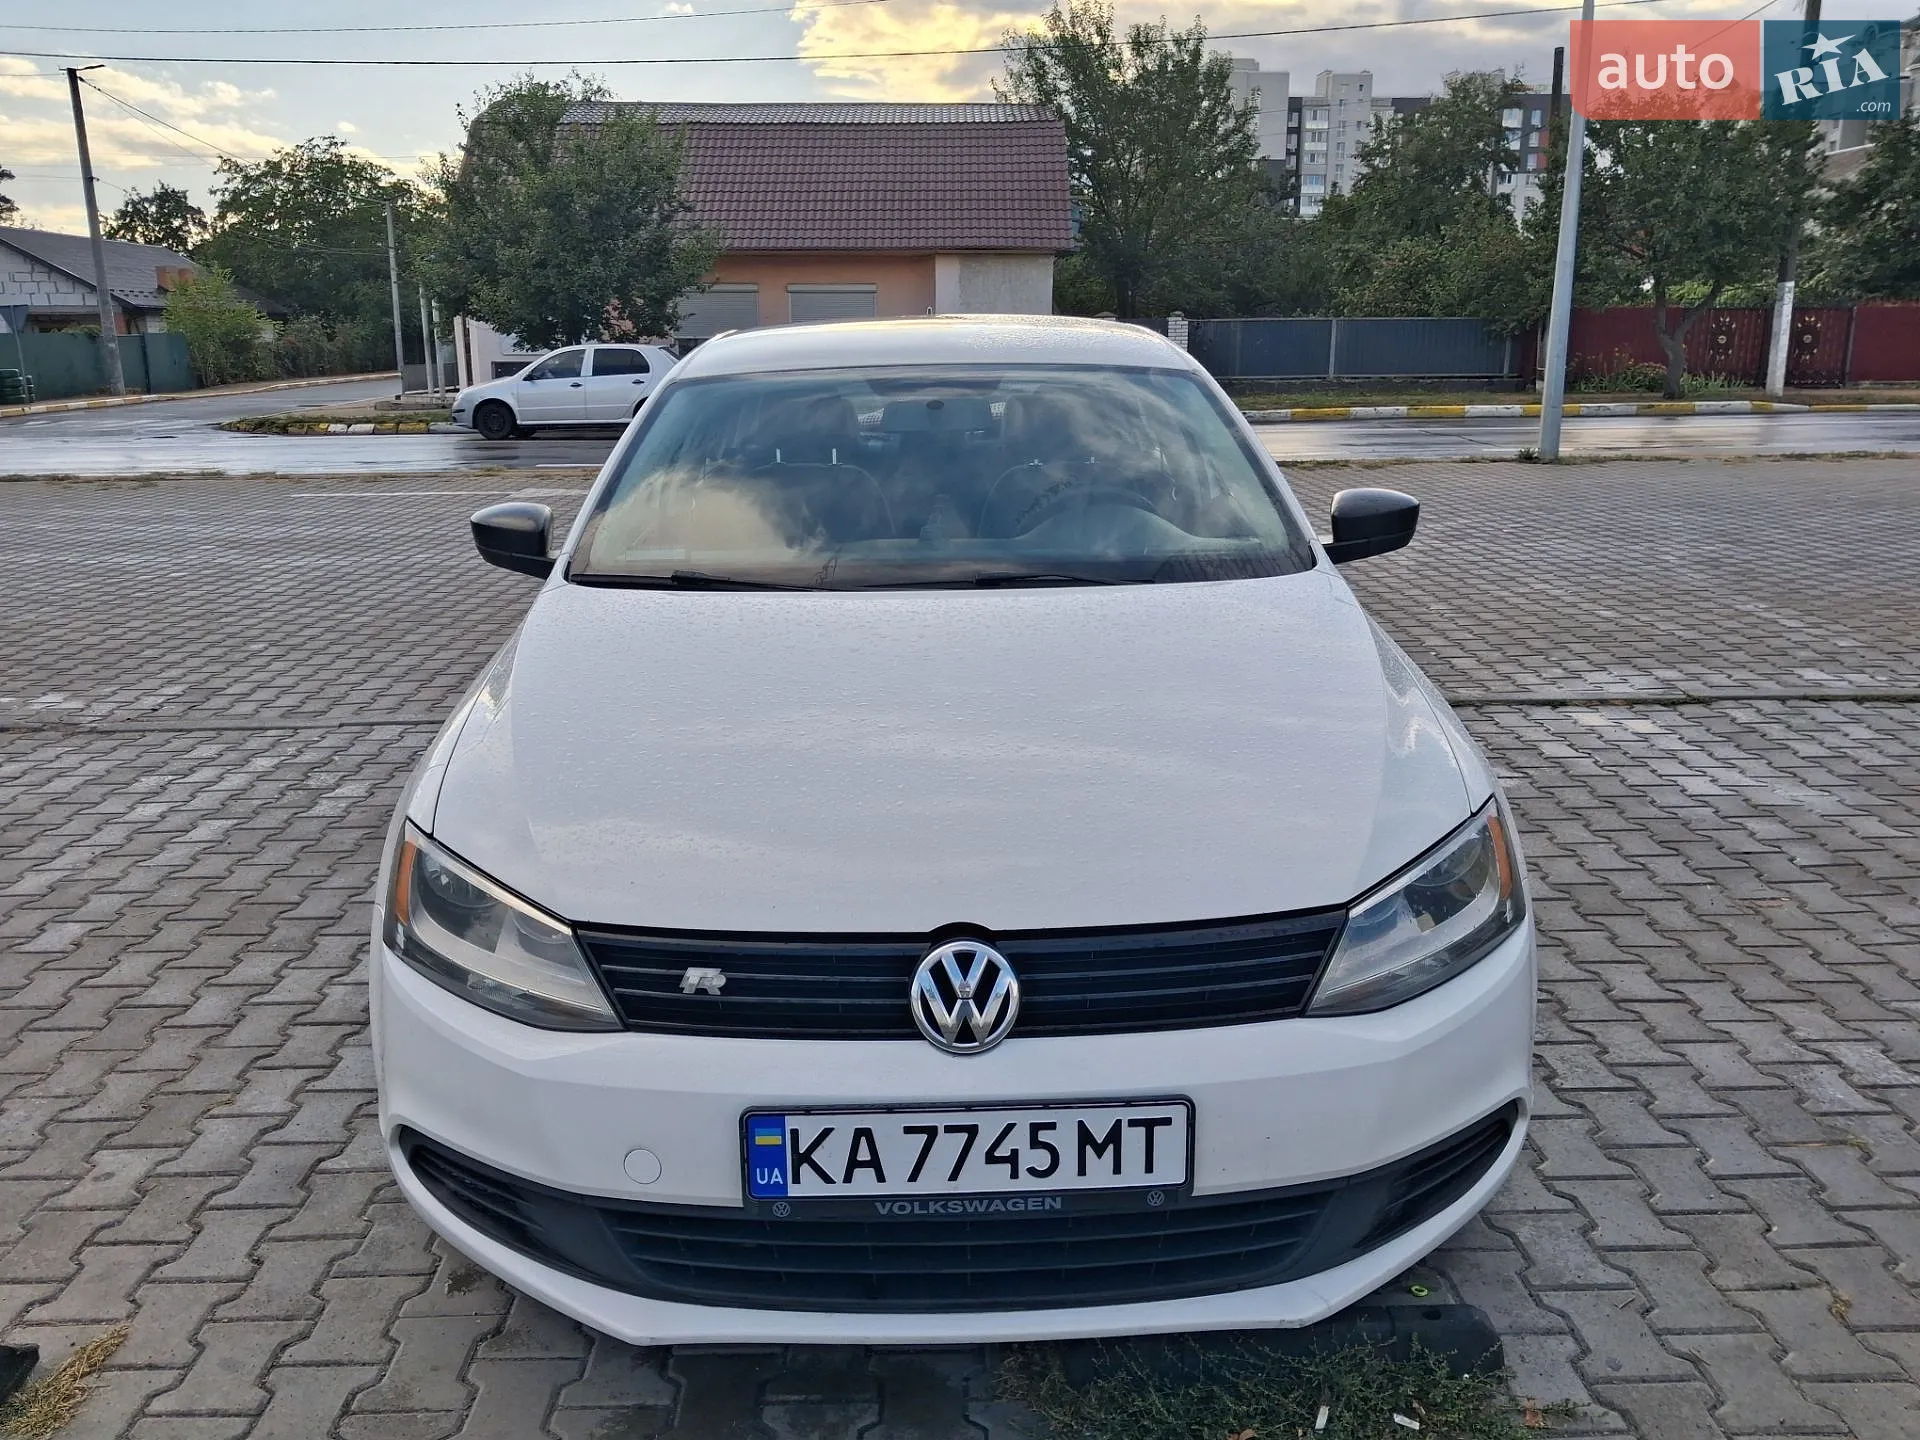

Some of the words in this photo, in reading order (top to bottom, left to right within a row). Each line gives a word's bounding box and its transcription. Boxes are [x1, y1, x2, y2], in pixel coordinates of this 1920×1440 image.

[789, 1126, 887, 1185] KA
[903, 1121, 1060, 1183] 7745
[1077, 1117, 1173, 1177] MT
[756, 1167, 783, 1185] UA
[874, 1197, 1062, 1216] VOLKSWAGEN
